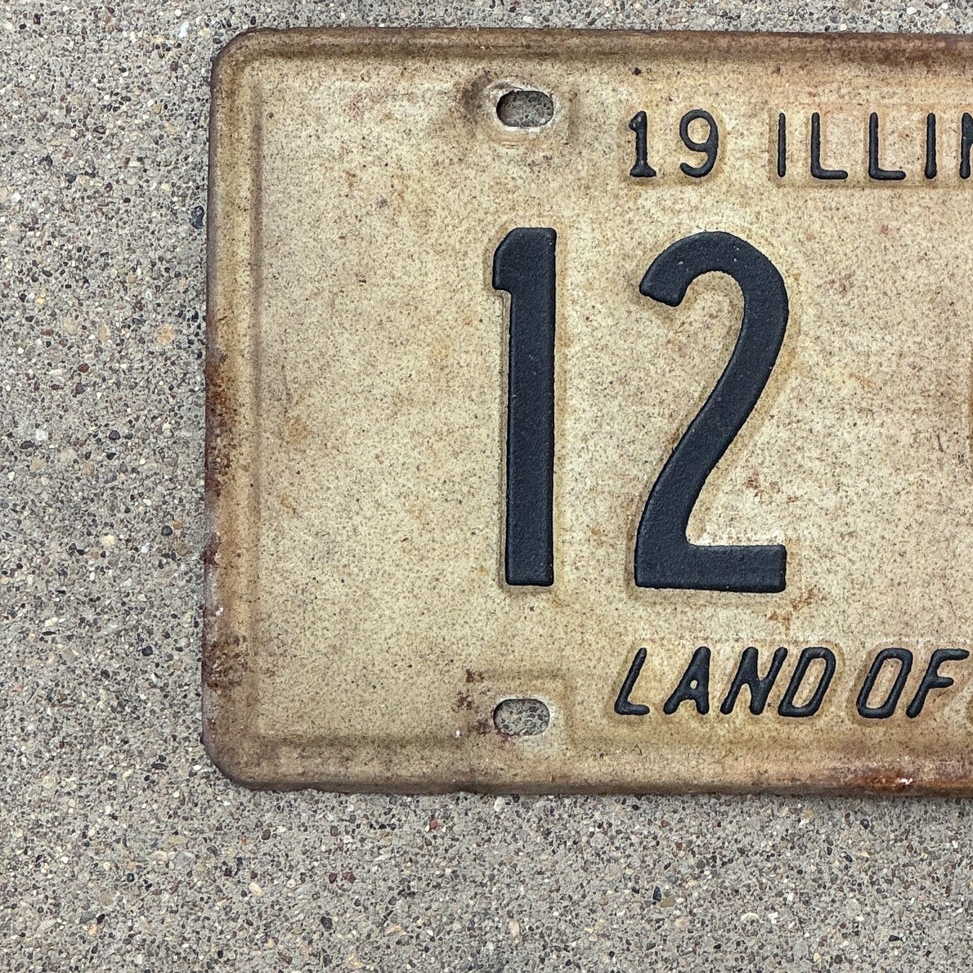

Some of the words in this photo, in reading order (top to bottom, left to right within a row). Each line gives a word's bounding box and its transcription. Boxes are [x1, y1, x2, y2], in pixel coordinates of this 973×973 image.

[629, 109, 719, 178] 19
[492, 228, 789, 593] 12
[614, 647, 836, 719] LAND
[856, 648, 969, 719] OF
